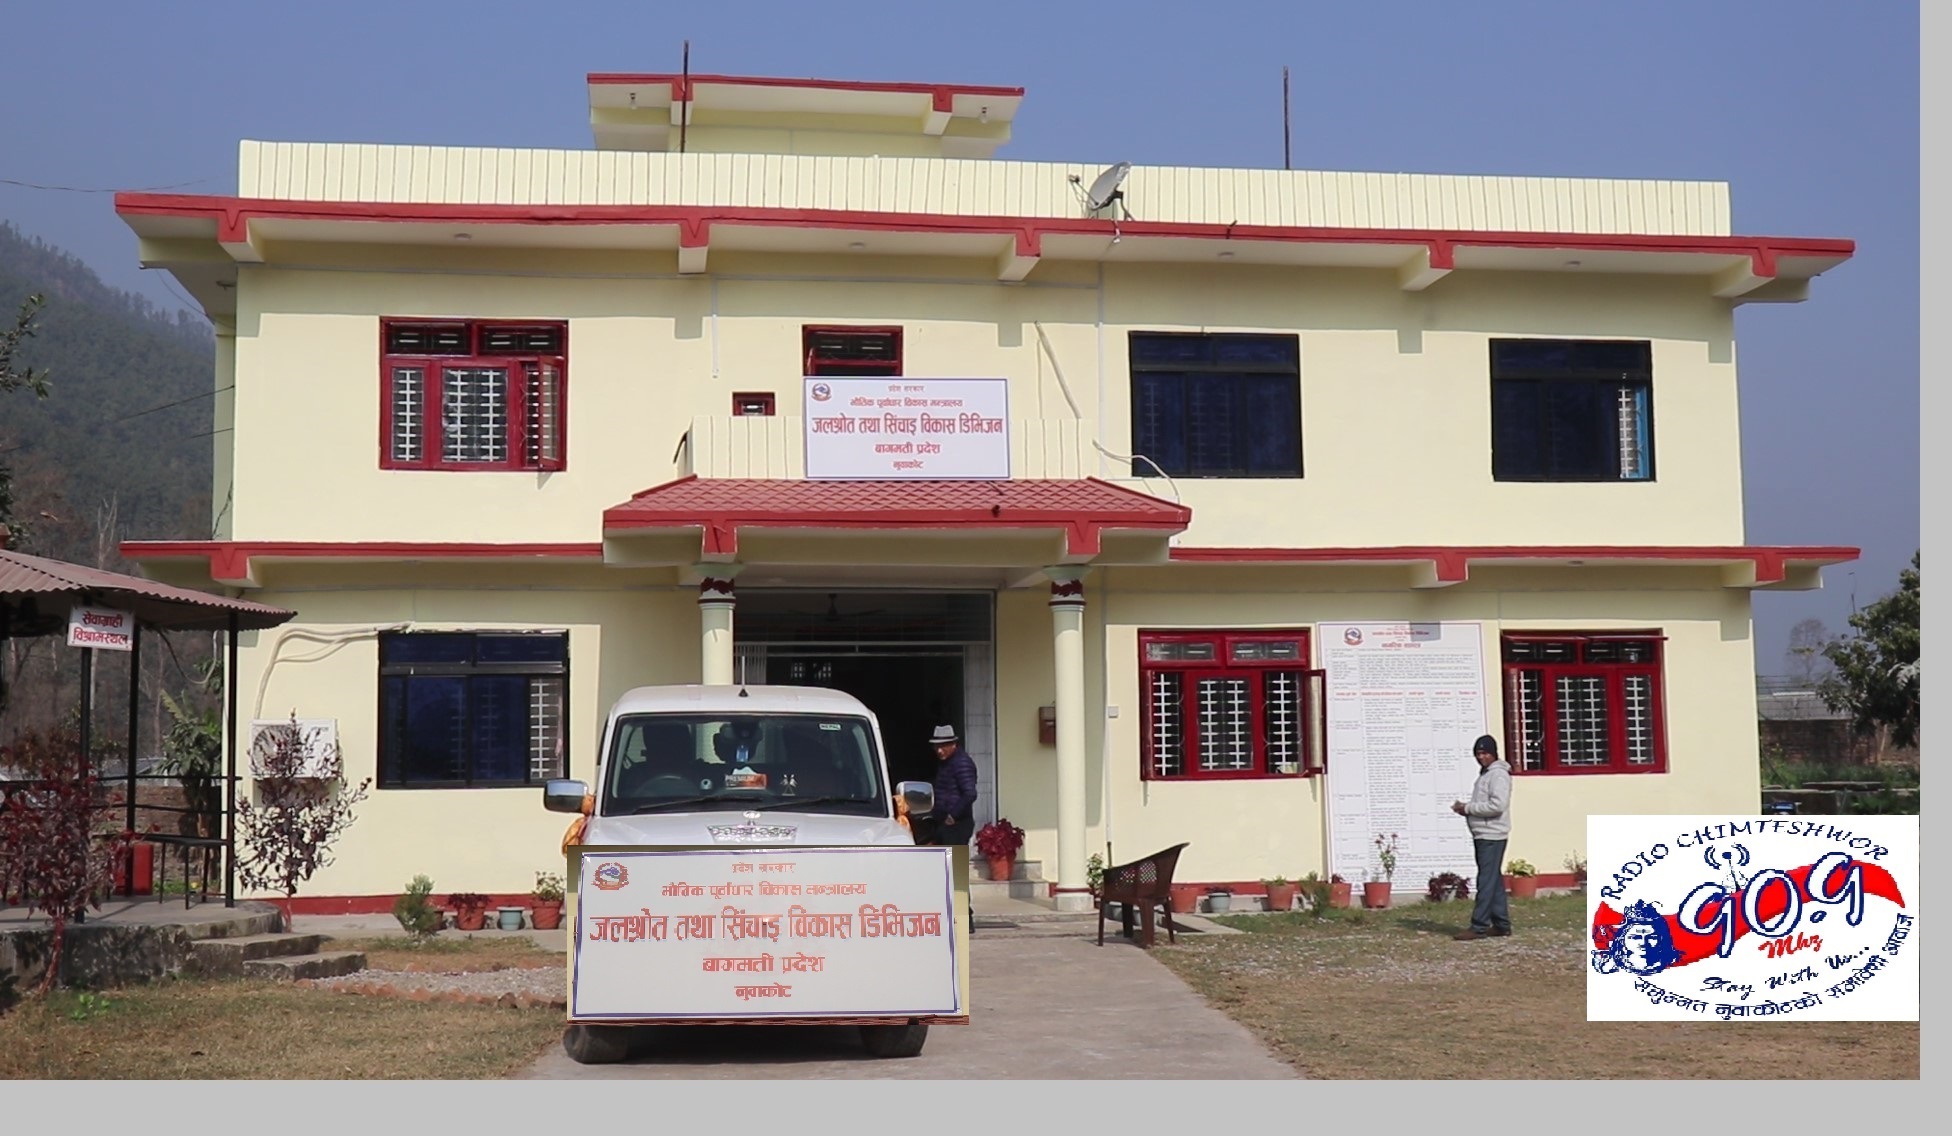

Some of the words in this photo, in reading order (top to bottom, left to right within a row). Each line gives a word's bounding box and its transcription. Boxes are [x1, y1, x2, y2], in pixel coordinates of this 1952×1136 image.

[904, 397, 927, 407] विकास
[859, 416, 880, 434] तथा
[920, 412, 955, 434] विकास
[875, 443, 913, 453] बागमती
[917, 442, 941, 454] प्रदेश
[893, 459, 924, 471] नुवाकोट
